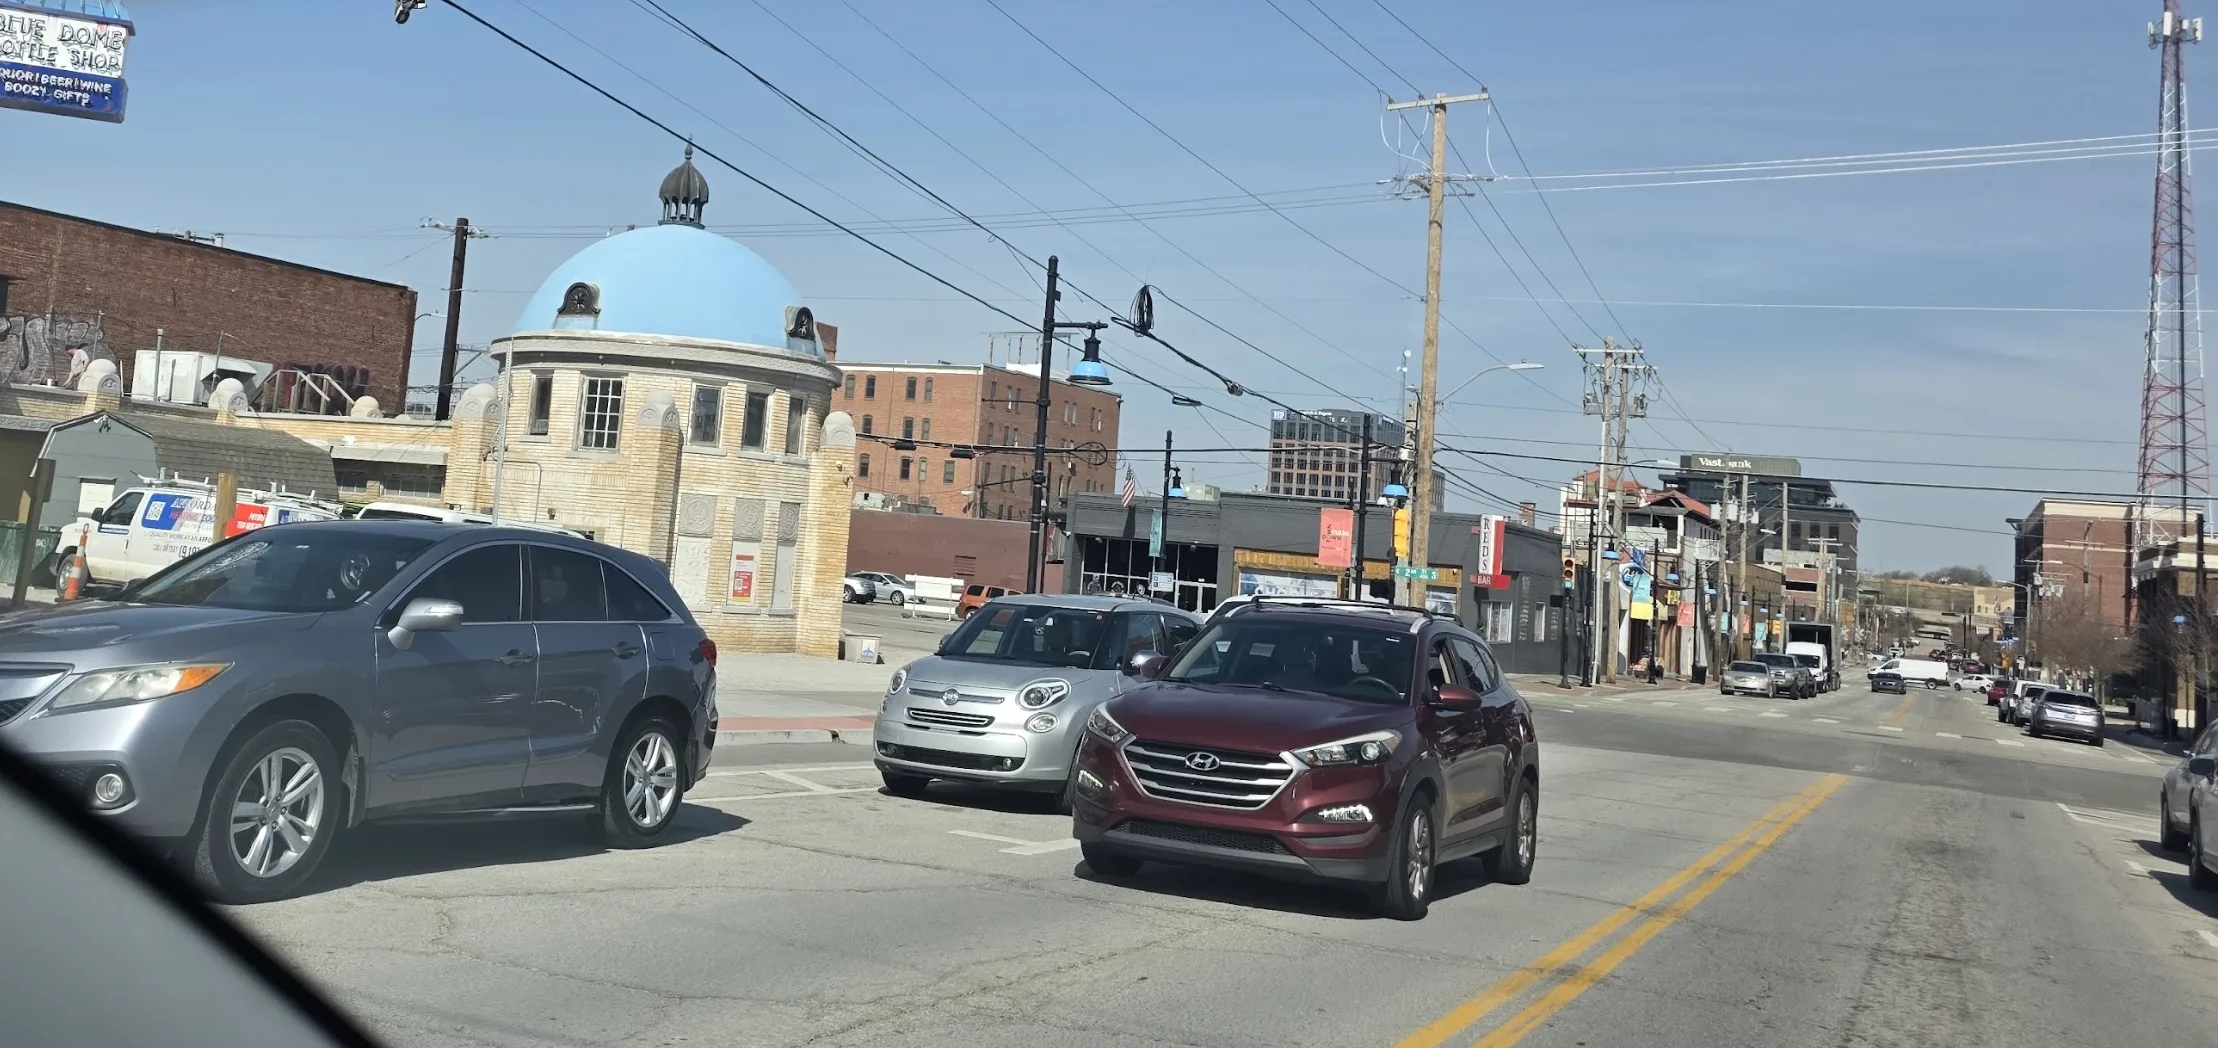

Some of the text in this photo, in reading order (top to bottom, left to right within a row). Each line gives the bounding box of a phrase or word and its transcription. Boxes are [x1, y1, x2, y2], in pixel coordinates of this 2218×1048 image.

[58, 23, 123, 51] DOME
[0, 39, 120, 70] OTTLE SHOP
[4, 82, 46, 97] BOOZY
[1482, 517, 1490, 571] REDS
[1477, 575, 1491, 586] BAR
